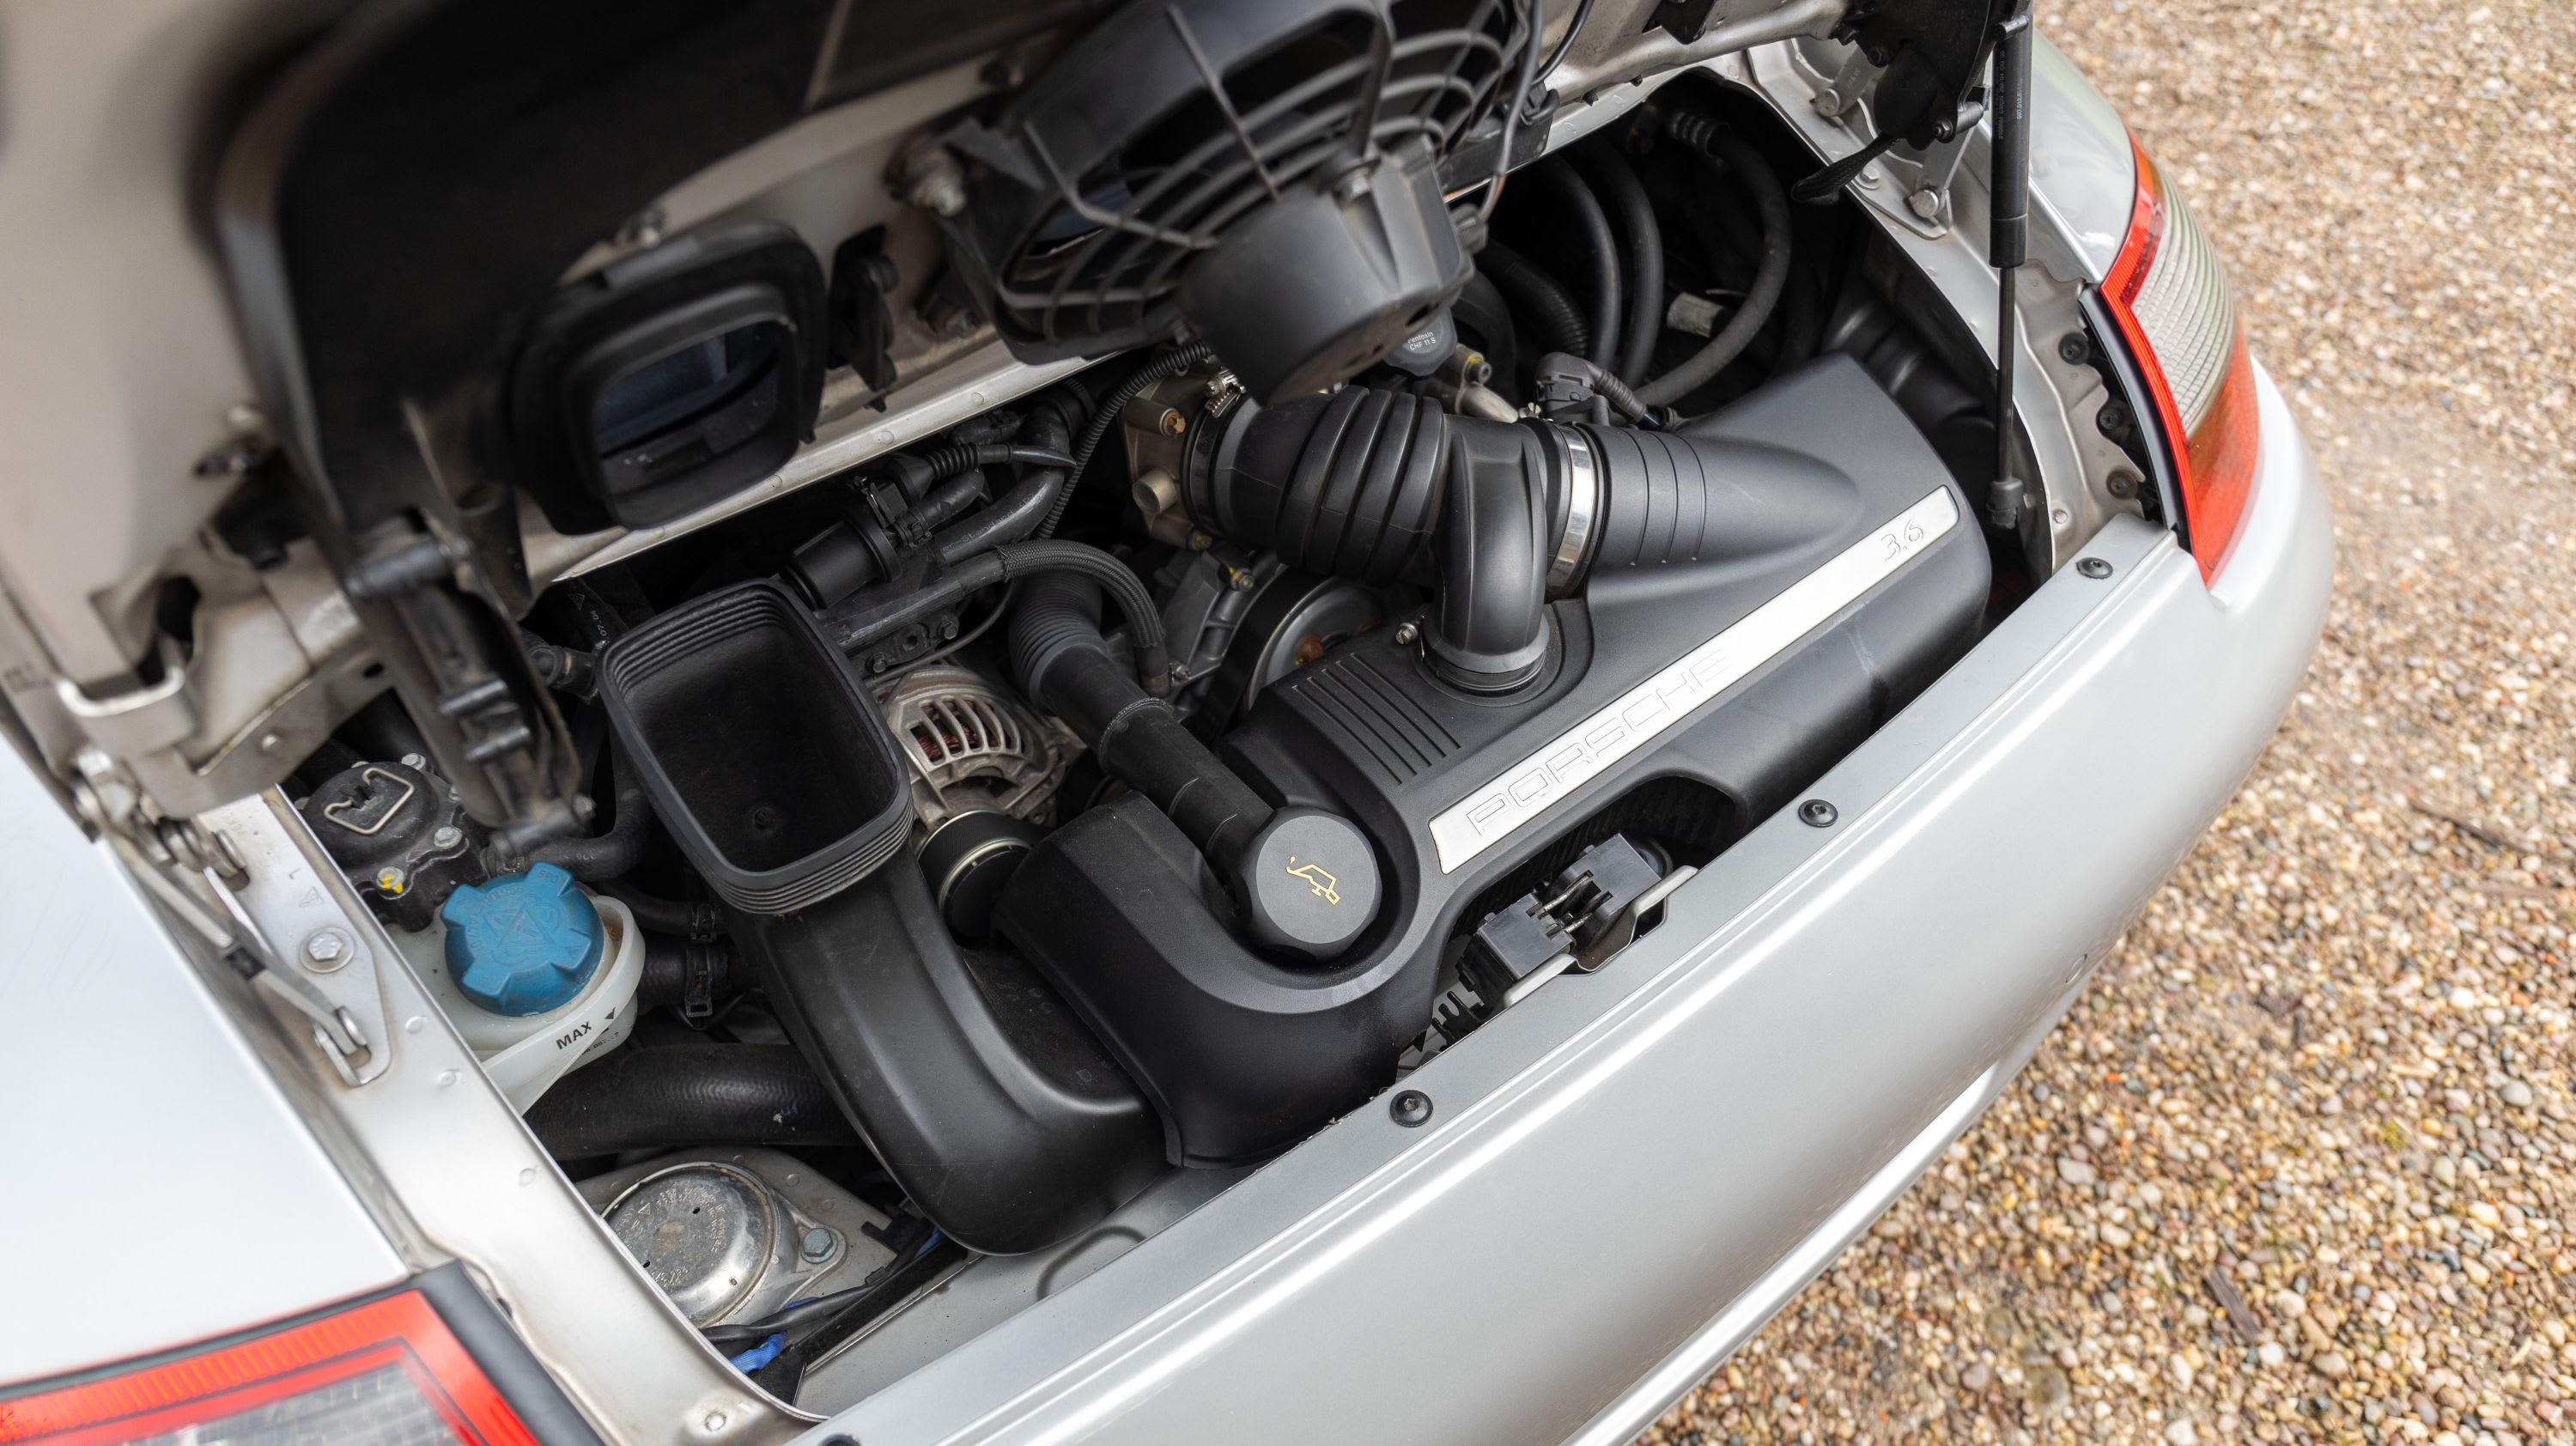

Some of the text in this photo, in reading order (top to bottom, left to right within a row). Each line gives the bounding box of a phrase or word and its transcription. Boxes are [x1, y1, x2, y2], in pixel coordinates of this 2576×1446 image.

[1409, 342, 1423, 350] CHF
[1880, 519, 1923, 562] 3.6
[1465, 648, 1733, 836] PORSCHE
[556, 1021, 592, 1050] MAX
